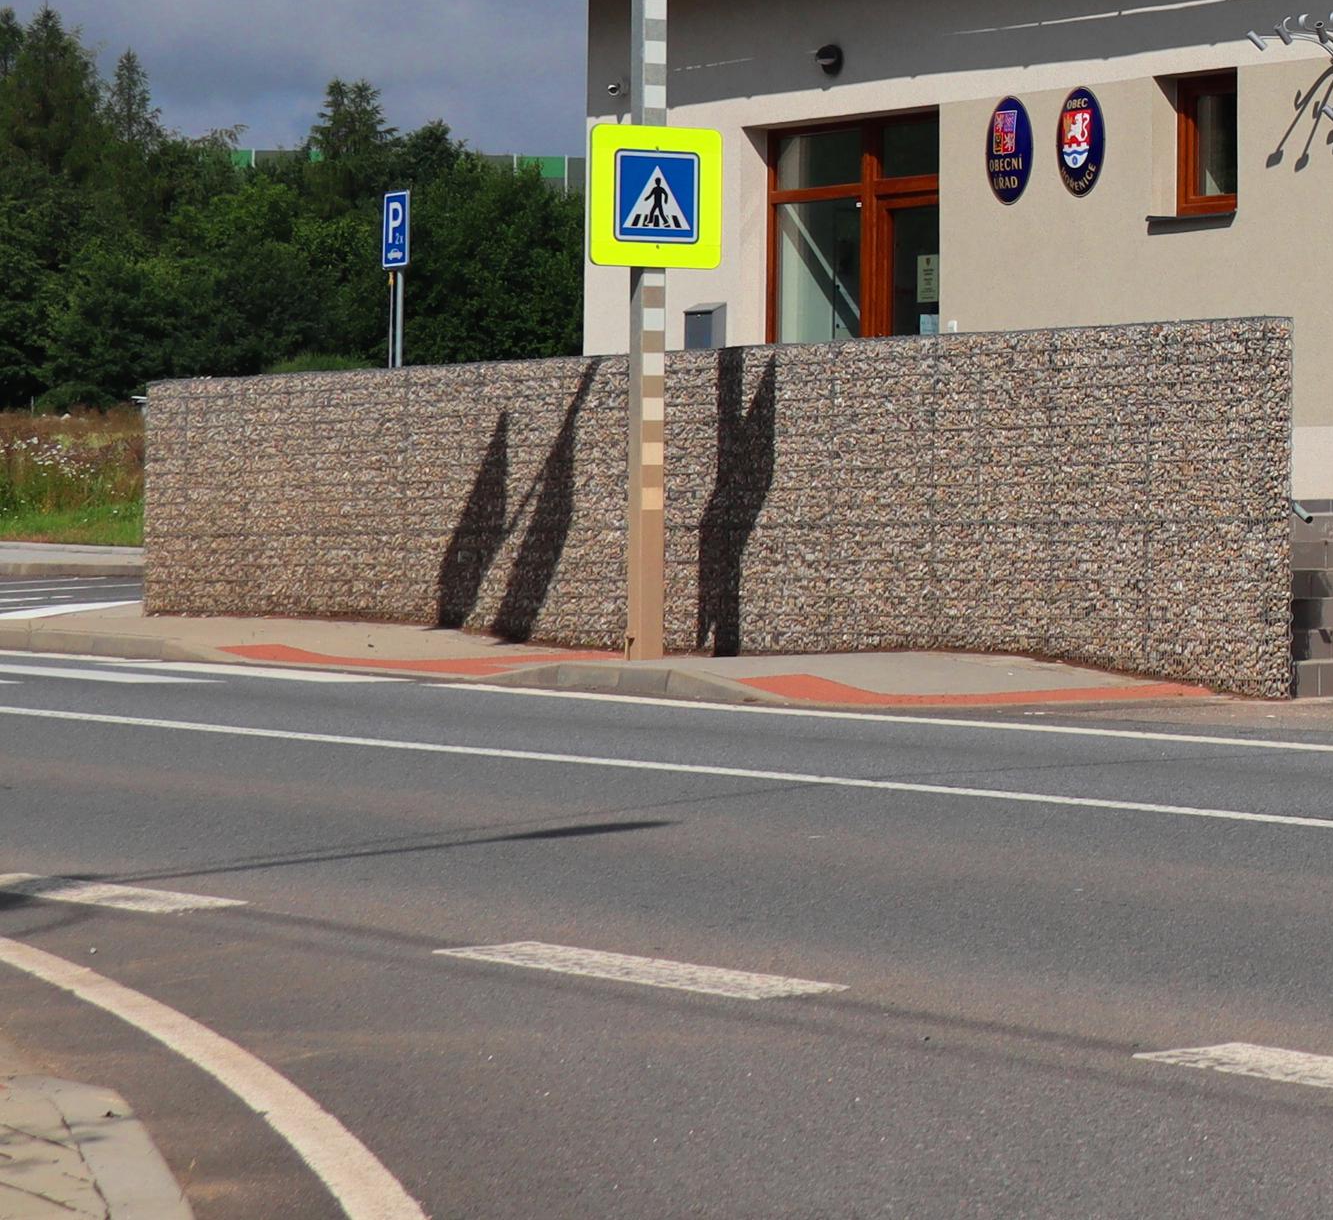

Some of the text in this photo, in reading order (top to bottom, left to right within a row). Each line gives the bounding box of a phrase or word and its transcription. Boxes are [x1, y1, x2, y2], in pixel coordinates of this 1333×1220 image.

[1066, 97, 1089, 110] OBEC
[989, 153, 1023, 173] OBECNÍ
[993, 173, 1018, 191] ÚŘAD
[388, 201, 403, 244] P
[395, 232, 404, 245] 2x
